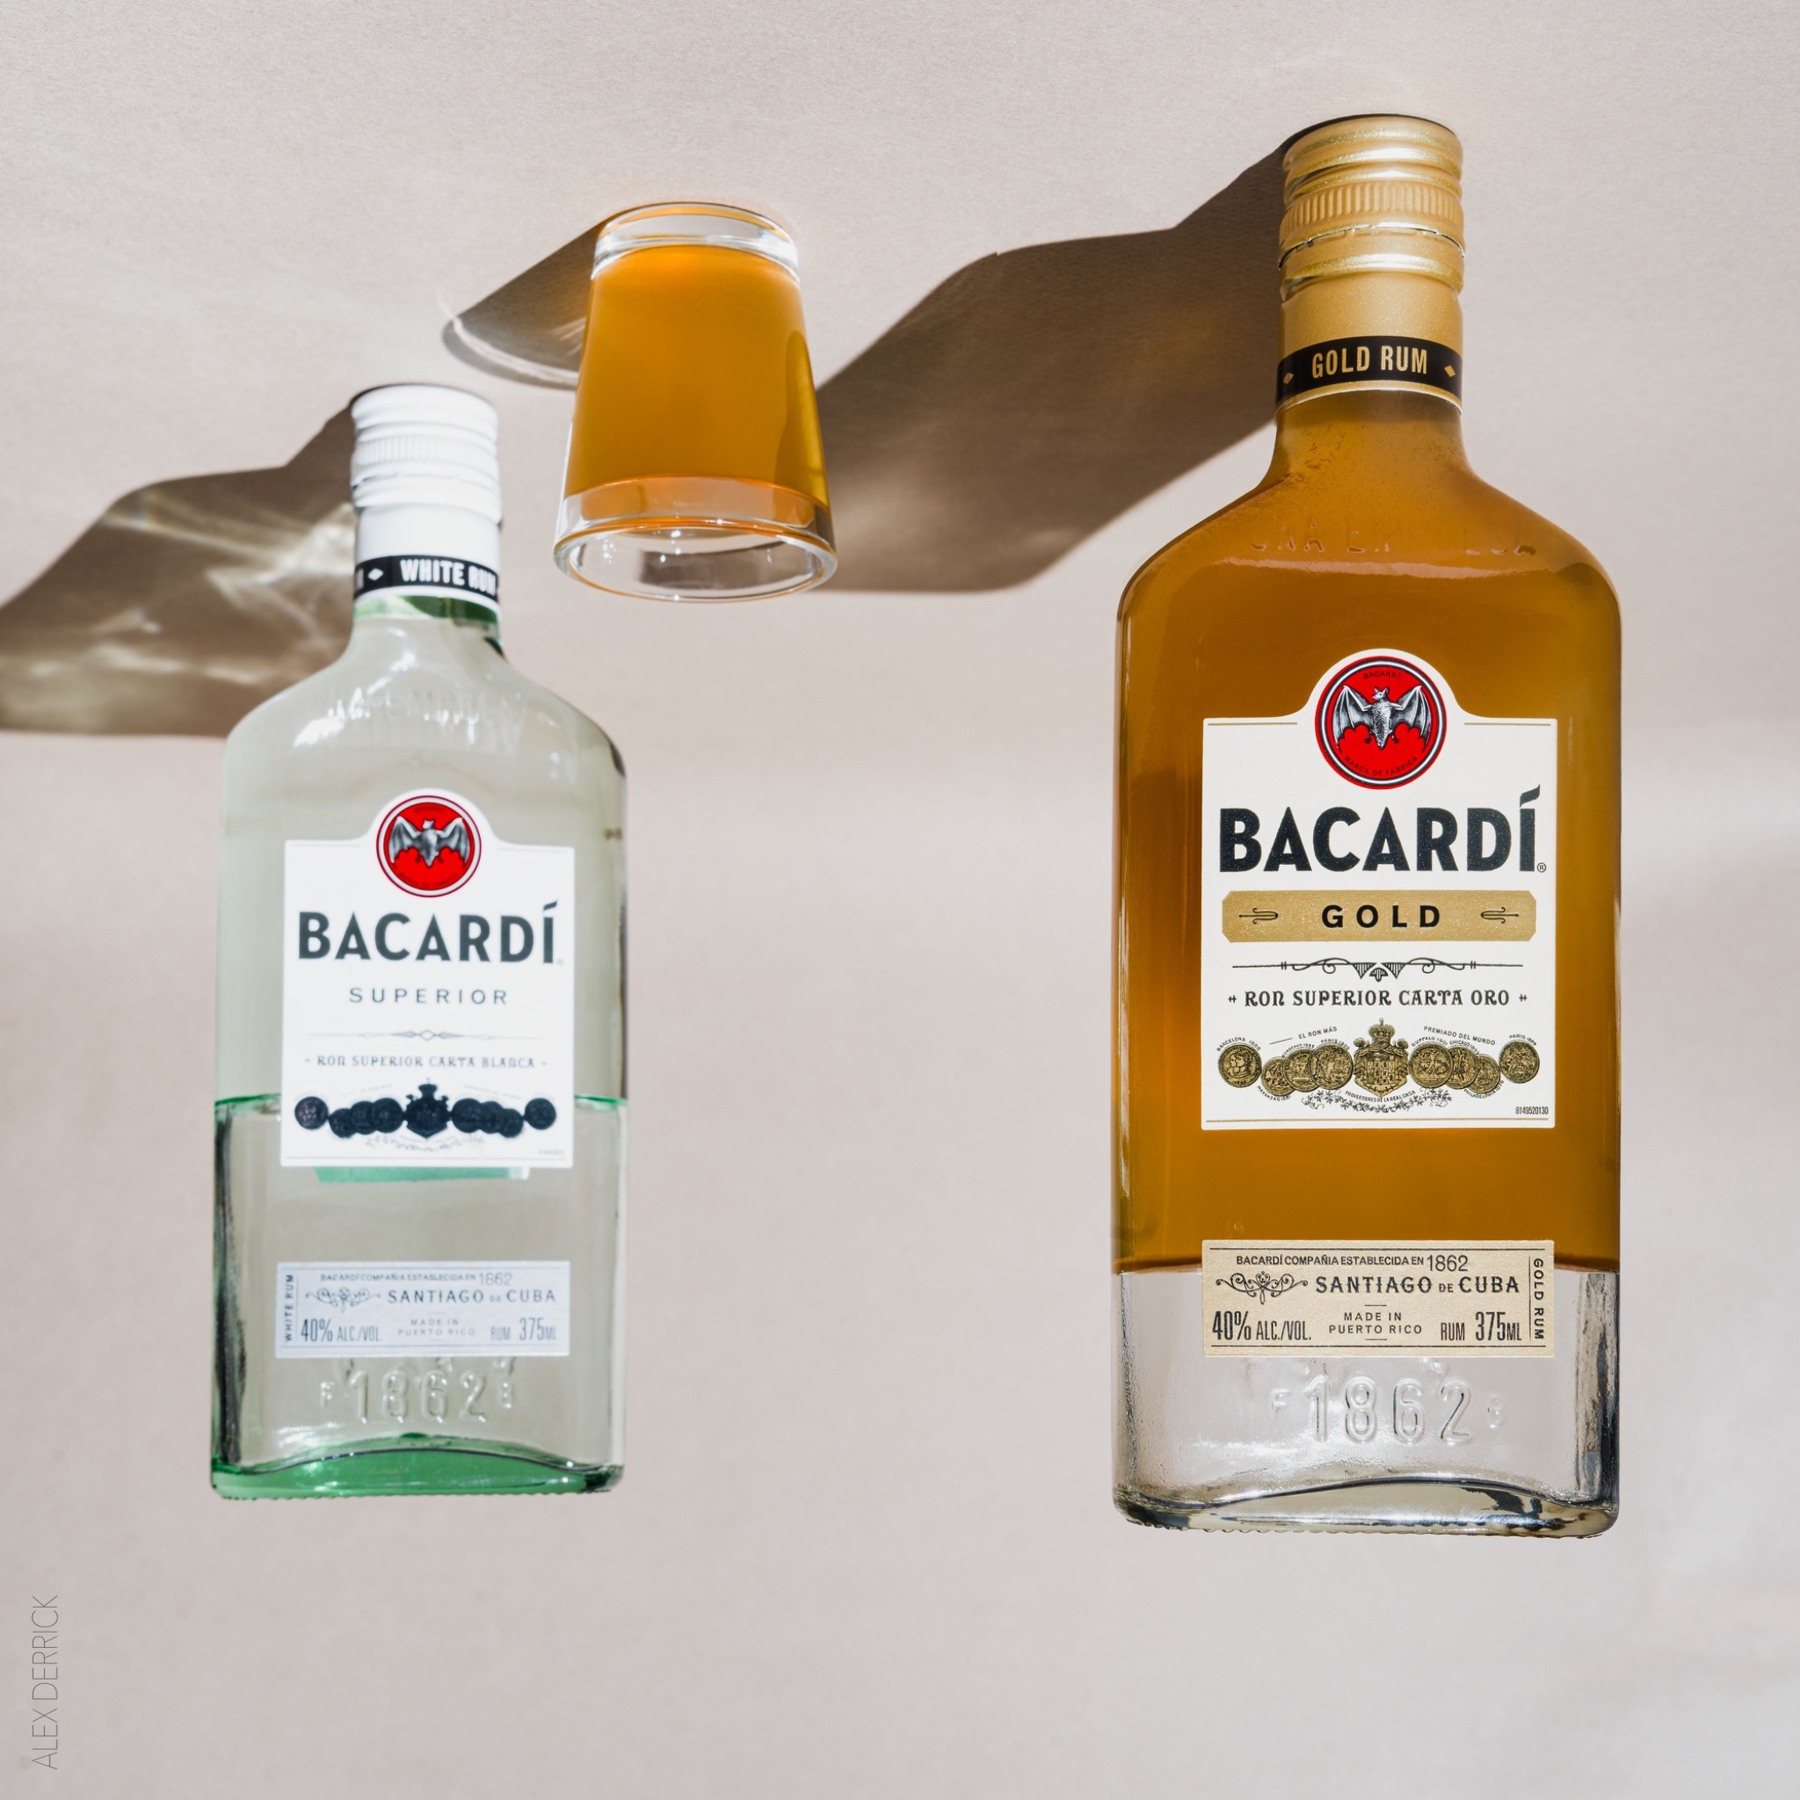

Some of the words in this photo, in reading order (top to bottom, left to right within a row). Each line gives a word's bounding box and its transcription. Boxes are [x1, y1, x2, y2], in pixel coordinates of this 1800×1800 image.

[1312, 346, 1370, 379] GOLD
[1380, 345, 1428, 375] RUM
[400, 558, 465, 586] WHITE
[1345, 756, 1369, 774] MARCA
[1321, 904, 1440, 929] GOLD
[298, 900, 558, 963] BACARDÍ
[349, 987, 508, 1005] SUPERIOR
[1244, 990, 1285, 1007] RON
[1293, 990, 1392, 1006] SUPERIOR
[1399, 990, 1463, 1006] CARTA
[1470, 990, 1510, 1006] ORO
[1307, 1029, 1322, 1038] RON
[1323, 1026, 1338, 1035] MÁS
[1423, 1026, 1457, 1038] PREMIADO
[1458, 1032, 1471, 1041] DEL
[1472, 1036, 1496, 1046] MUNDO
[1411, 1036, 1435, 1047] BUFFALO
[317, 1055, 346, 1068] RON
[352, 1055, 424, 1068] SUPERIOR
[429, 1056, 476, 1068] CARTA
[482, 1056, 535, 1069] BLANCA
[1236, 1254, 1283, 1265] BACARDÍ
[1285, 1254, 1339, 1265] COMPAÑIA
[1341, 1256, 1409, 1266] ESTABLECIDA
[1411, 1256, 1424, 1265] EN
[1427, 1254, 1469, 1272] 1862
[285, 1274, 294, 1299] RUM
[480, 1272, 513, 1286] 1862
[1315, 1276, 1432, 1294] SANTIAGO
[1439, 1283, 1454, 1293] DE
[1458, 1276, 1520, 1293] CUBA
[1533, 1258, 1544, 1301] GOLD
[388, 1289, 484, 1303] SANTIAGO
[489, 1295, 501, 1303] DE
[506, 1289, 556, 1303] CUBA
[284, 1304, 294, 1342] WHITE
[410, 1318, 441, 1326] MADE
[447, 1318, 458, 1326] IN
[1212, 1310, 1251, 1341] 40%
[1256, 1320, 1312, 1341] ALC./VOL.
[1344, 1312, 1382, 1321] MADE
[1389, 1312, 1402, 1321] IN
[1534, 1307, 1545, 1340] RUM
[300, 1318, 333, 1342] 40%
[398, 1328, 442, 1336] PUERTO
[490, 1326, 511, 1340] RUM
[1329, 1324, 1383, 1334] PUERTO
[1389, 1324, 1422, 1334] RICO
[1440, 1322, 1466, 1341] RUM
[1475, 1311, 1522, 1341] 375ML
[349, 1369, 488, 1424] 1862
[1304, 1374, 1472, 1446] 1862
